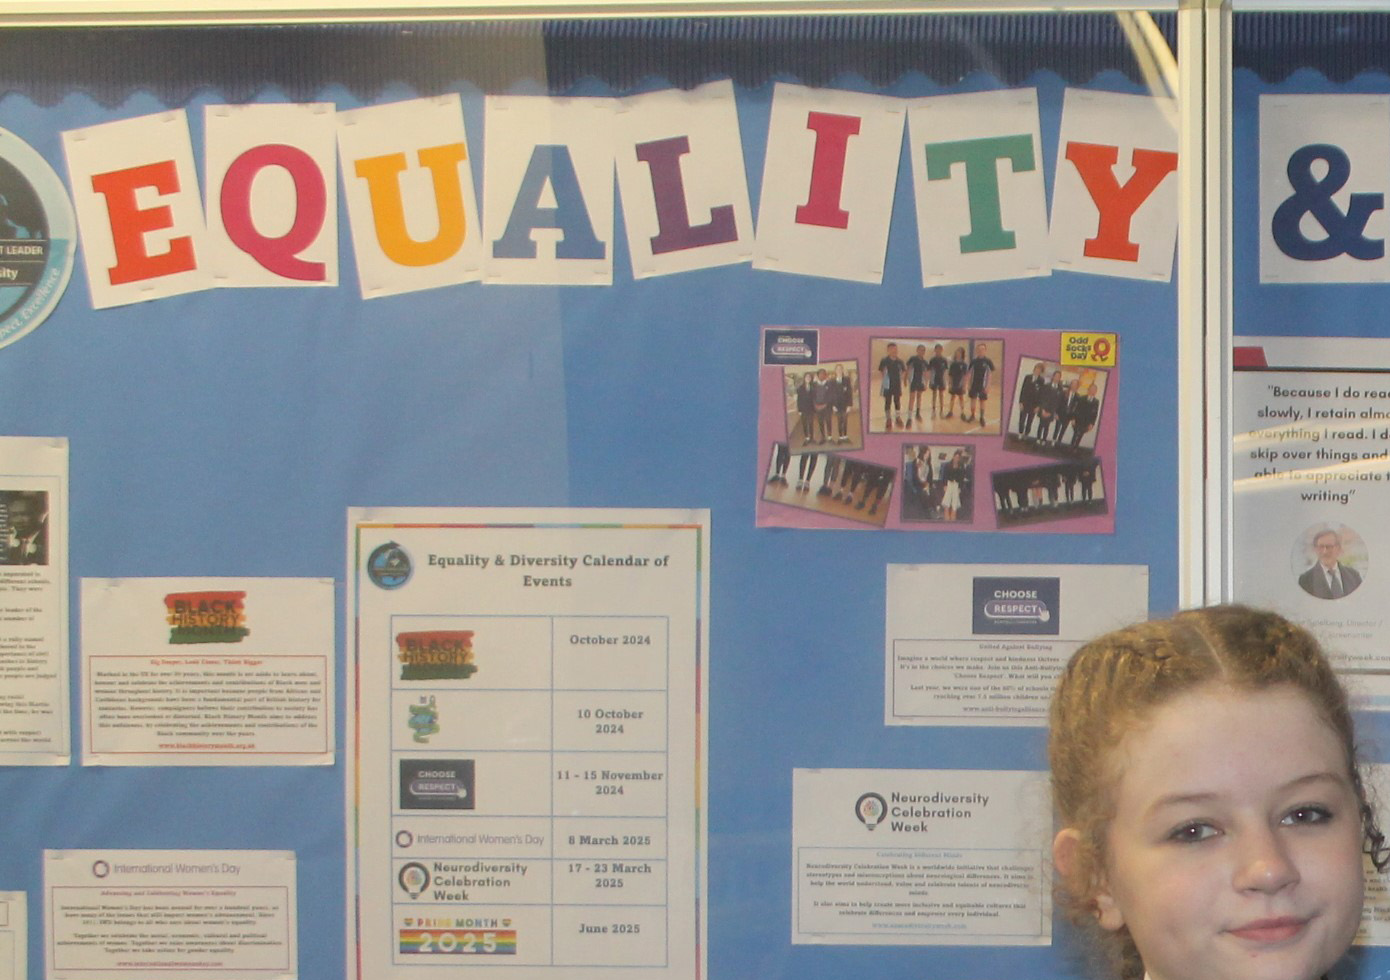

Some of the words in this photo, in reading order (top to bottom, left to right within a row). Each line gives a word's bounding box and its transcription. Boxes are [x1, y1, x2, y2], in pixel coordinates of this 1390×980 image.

[90, 111, 1179, 286] EQUALITY
[1272, 143, 1385, 262] &
[7, 246, 44, 256] LEADER
[1069, 336, 1089, 345] Odd
[1066, 344, 1092, 352] Socks
[1070, 352, 1088, 361] Day
[1268, 386, 1331, 398] "Because
[1336, 387, 1338, 398] I
[1343, 386, 1360, 398] do
[1258, 406, 1303, 422] slowly,
[1308, 407, 1311, 419] I
[1316, 407, 1355, 419] retain
[1324, 430, 1329, 439] I
[1333, 429, 1368, 440] read.
[1373, 429, 1376, 440] I
[1250, 449, 1278, 463] skip
[1283, 452, 1311, 460] over
[1316, 449, 1358, 463] things
[1362, 450, 1388, 461] and
[428, 554, 489, 569] Equality
[495, 555, 504, 566] &
[510, 554, 577, 569] Diversity
[583, 554, 649, 566] Calendar
[654, 554, 669, 566] of
[523, 575, 572, 586] Events
[994, 590, 1037, 599] CHOOSE
[174, 601, 236, 614] BLACK
[994, 604, 1037, 614] RESPECT
[172, 614, 240, 626] HISTORY
[570, 635, 618, 644] October
[623, 636, 650, 645] 2024
[578, 709, 591, 718] 10
[595, 709, 643, 718] October
[596, 724, 624, 733] 2024
[558, 771, 569, 780] 11
[584, 771, 597, 780] 15
[602, 770, 663, 780] November
[596, 786, 623, 795] 2024
[891, 792, 989, 806] Neurodiversity
[891, 807, 972, 819] Celebration
[891, 821, 928, 833] Week
[417, 834, 476, 844] International
[478, 834, 523, 844] Women's
[525, 834, 544, 846] Day
[569, 836, 575, 845] 8
[580, 835, 618, 846] March
[623, 835, 650, 845] 2025
[114, 864, 173, 873] International
[175, 864, 219, 873] Women's
[222, 863, 240, 875] Day
[433, 862, 528, 876] Neurodiversity
[569, 864, 582, 872] 17
[594, 864, 607, 873] 23
[612, 863, 651, 873] March
[434, 876, 511, 888] Celebration
[596, 879, 623, 888] 2025
[434, 890, 470, 902] Week
[579, 924, 608, 933] June
[612, 924, 640, 933] 2025
[419, 933, 497, 953] 2025
